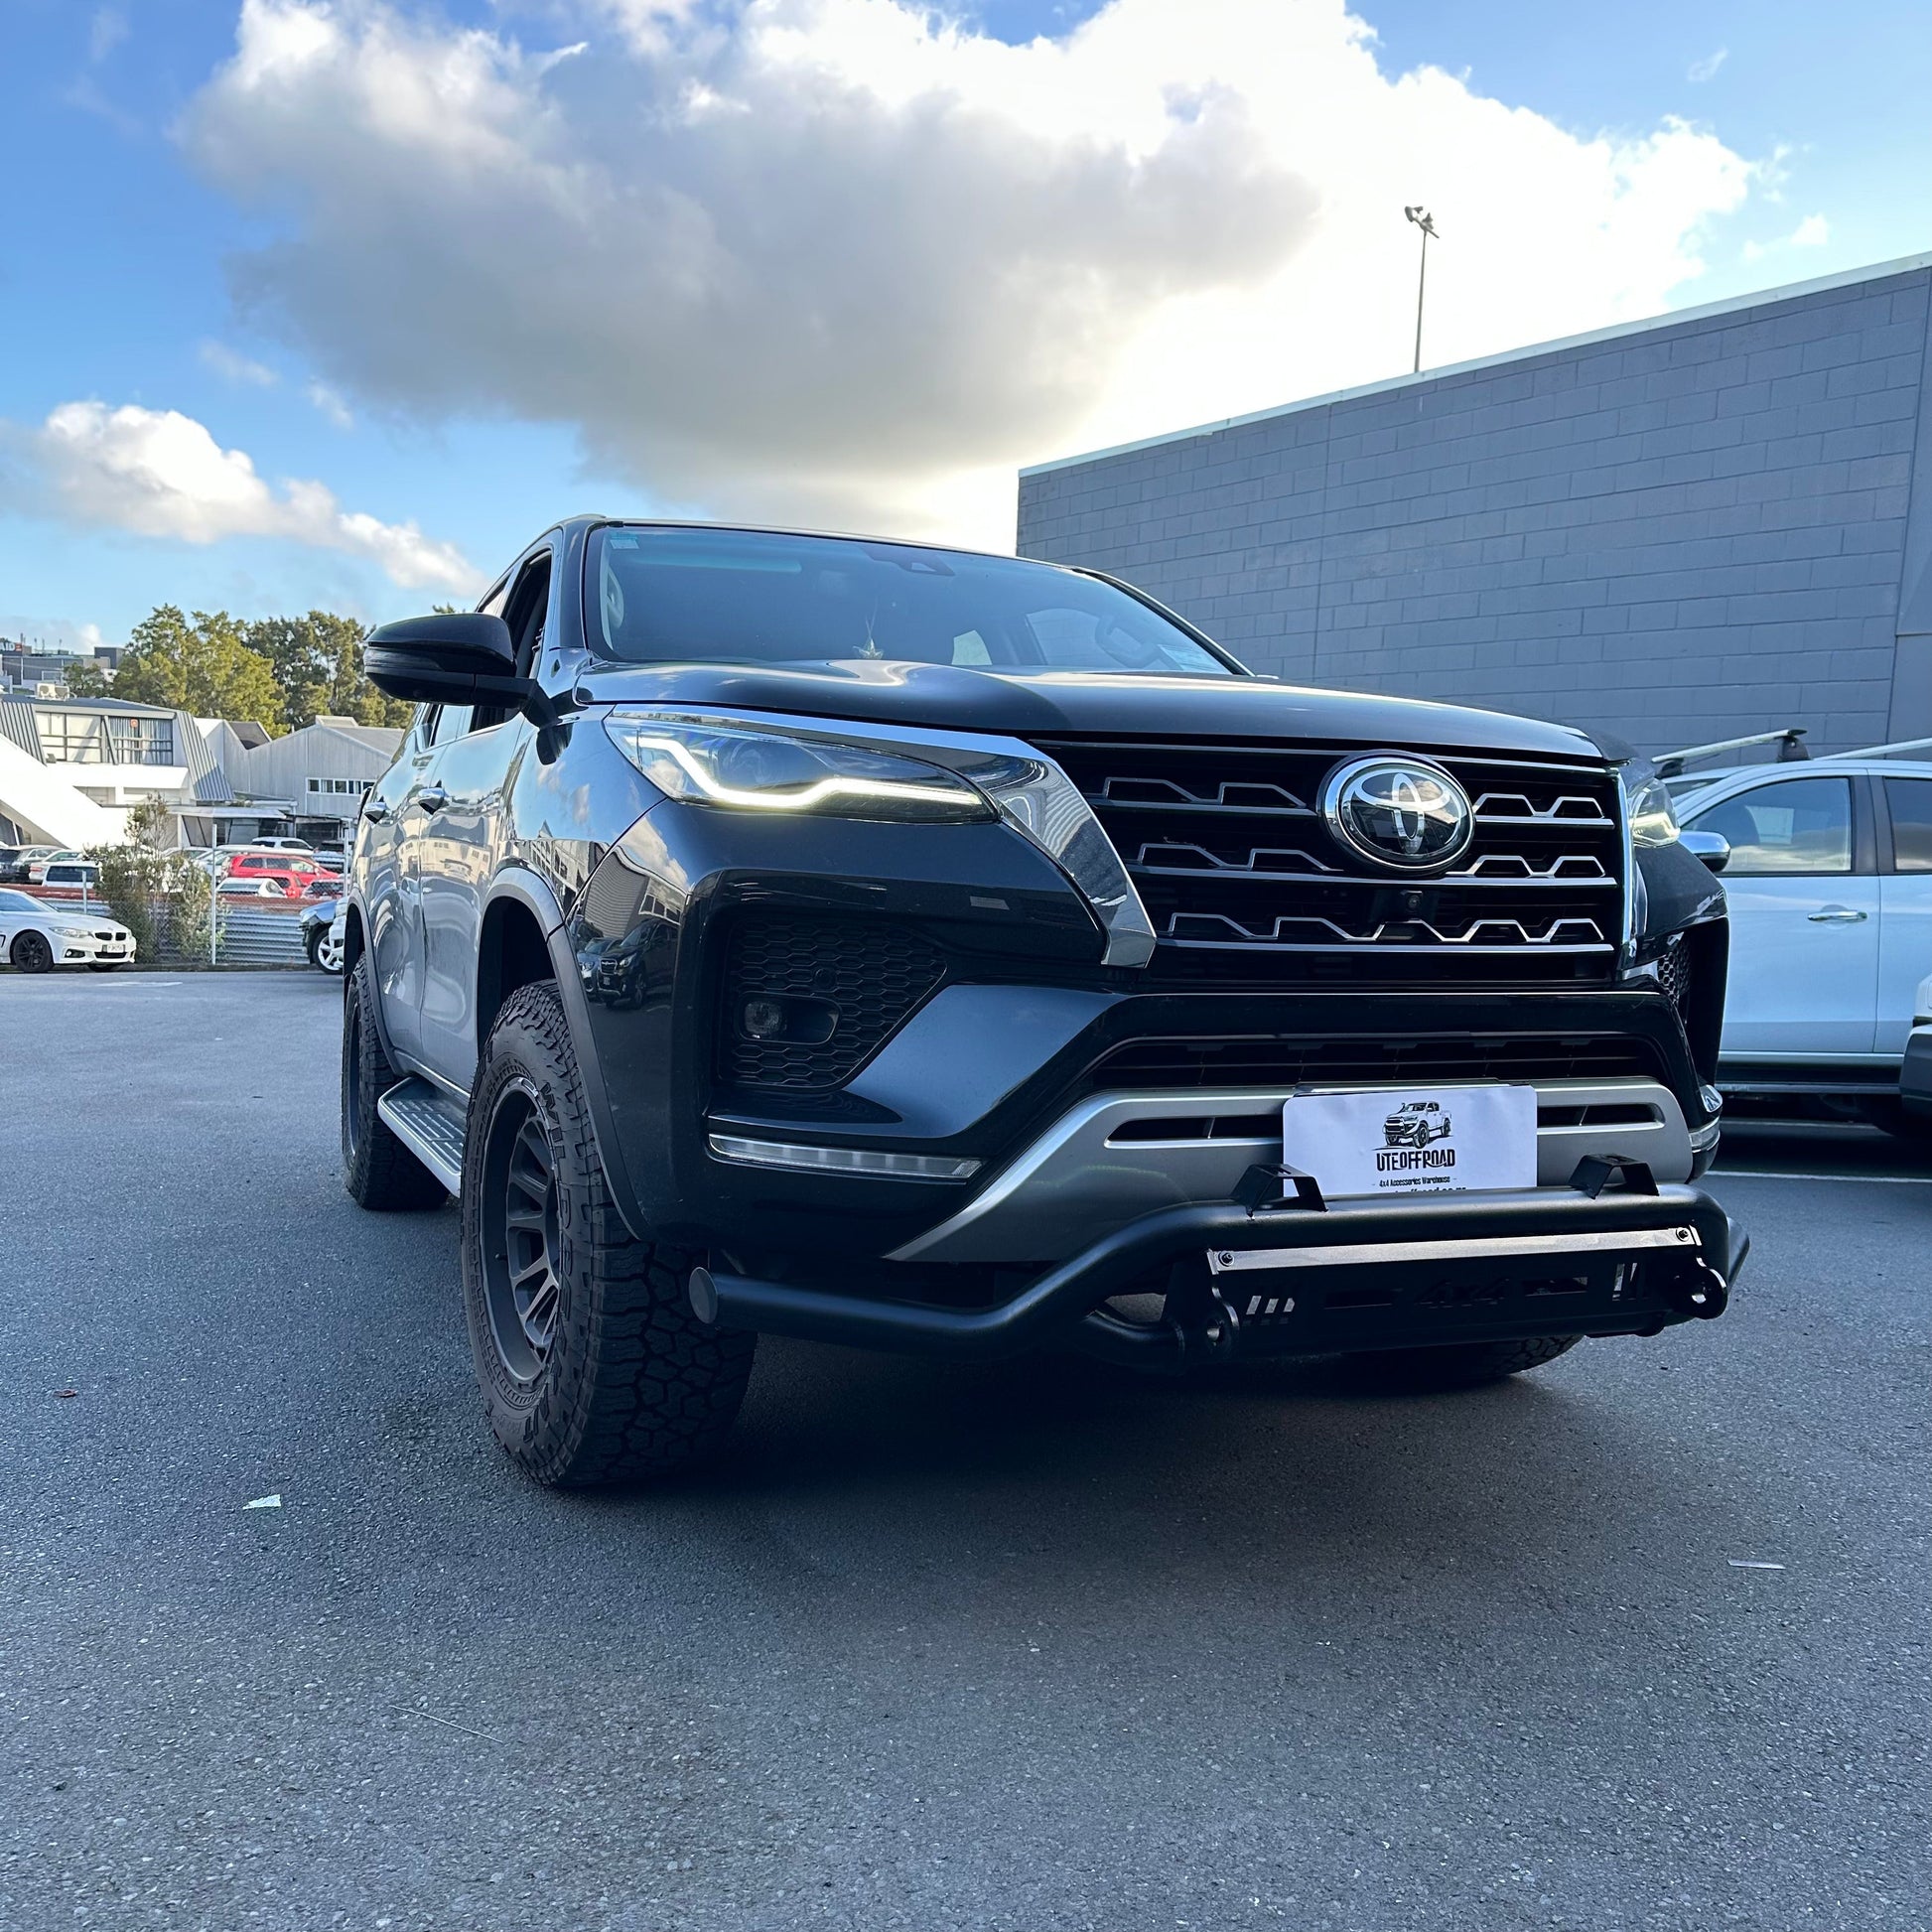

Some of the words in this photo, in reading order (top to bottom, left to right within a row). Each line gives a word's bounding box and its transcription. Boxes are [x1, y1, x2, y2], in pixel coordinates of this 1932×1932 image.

[1376, 1149, 1455, 1172] UTEOFFROAD
[1379, 1179, 1390, 1188] 4x4
[1390, 1177, 1422, 1187] Accessories
[1422, 1175, 1451, 1184] Warehouse
